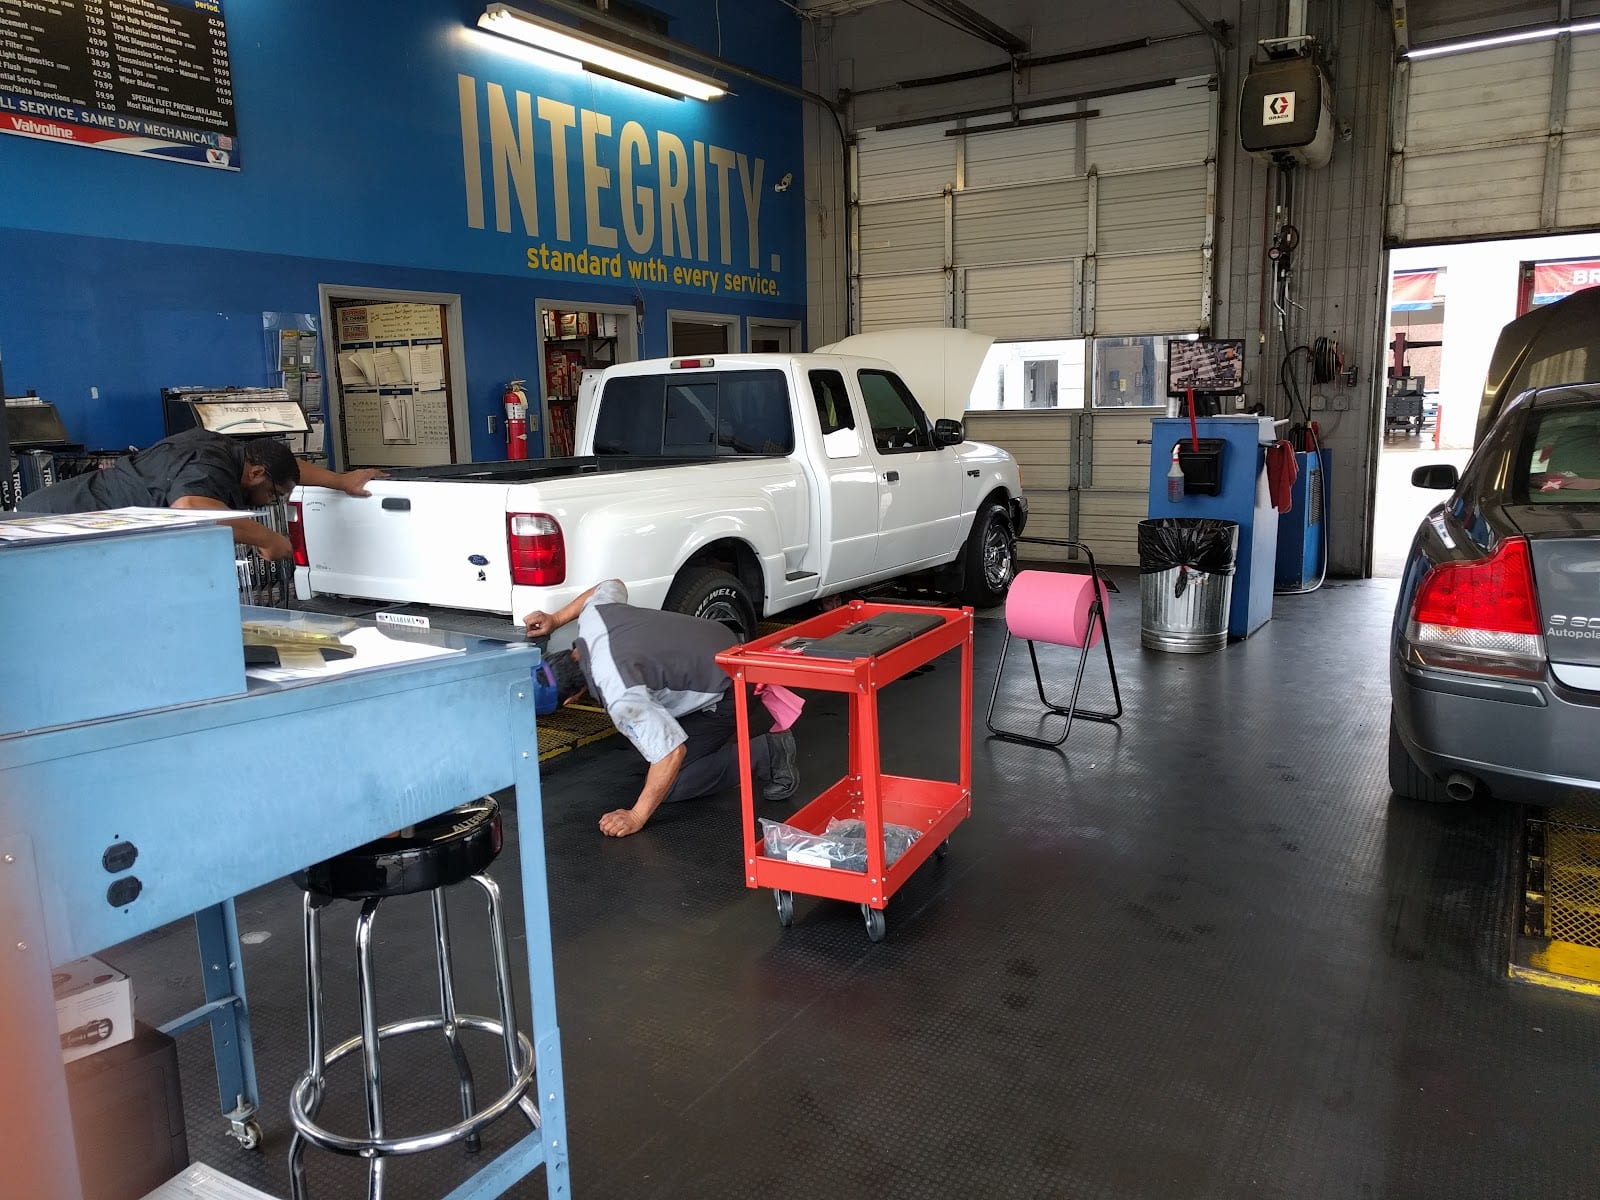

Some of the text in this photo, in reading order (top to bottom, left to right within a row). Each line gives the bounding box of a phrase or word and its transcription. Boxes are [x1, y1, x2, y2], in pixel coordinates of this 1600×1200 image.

[22, 0, 46, 12] Service
[86, 15, 105, 26] 79.99
[84, 4, 104, 16] 72.99
[109, 1, 122, 10] Fuel
[122, 4, 144, 16] System
[144, 10, 168, 24] Cleaning
[209, 28, 226, 38] 69.99
[88, 26, 106, 37] 13.99
[110, 12, 126, 22] Light
[141, 20, 176, 35] Replacement
[214, 39, 227, 48] 6.99
[112, 22, 124, 32] Tire
[124, 25, 150, 38] Rotation
[162, 35, 183, 46] Balance
[208, 18, 224, 28] 42.99
[5, 40, 23, 50] Filter
[91, 58, 110, 69] 38.99
[86, 47, 110, 58] 139.99
[88, 37, 108, 48] 49.99
[130, 37, 164, 52] Diagnostics
[17, 53, 54, 68] Diagnostics
[92, 70, 112, 80] 42.50
[114, 44, 152, 58] Transmission
[152, 53, 174, 64] Service
[214, 68, 230, 77] 99.99
[116, 54, 154, 69] Transmission
[154, 62, 175, 74] Service
[132, 68, 144, 77] Ups
[3, 62, 22, 72] Flush
[94, 80, 113, 90] 79.99
[16, 74, 40, 86] Service
[95, 90, 114, 100] 59.99
[34, 89, 70, 103] Inspections
[97, 102, 116, 112] 15.00
[118, 75, 136, 85] Wiper
[136, 80, 156, 90] Blades
[216, 96, 233, 106] 10.99
[126, 100, 228, 127] Most National Fleet Accounts Accepted
[131, 94, 223, 118] SPECIAL FLEET PRICING AVAILABLE
[11, 117, 74, 139] Valvoline
[20, 100, 78, 122] SERVICE,
[82, 110, 116, 128] SAME
[118, 120, 141, 132] DAY
[144, 124, 214, 145] MECHANICAL
[457, 73, 781, 272] INTEGRITY.
[527, 243, 780, 296] standard with every service.
[43, 467, 52, 488] TRI
